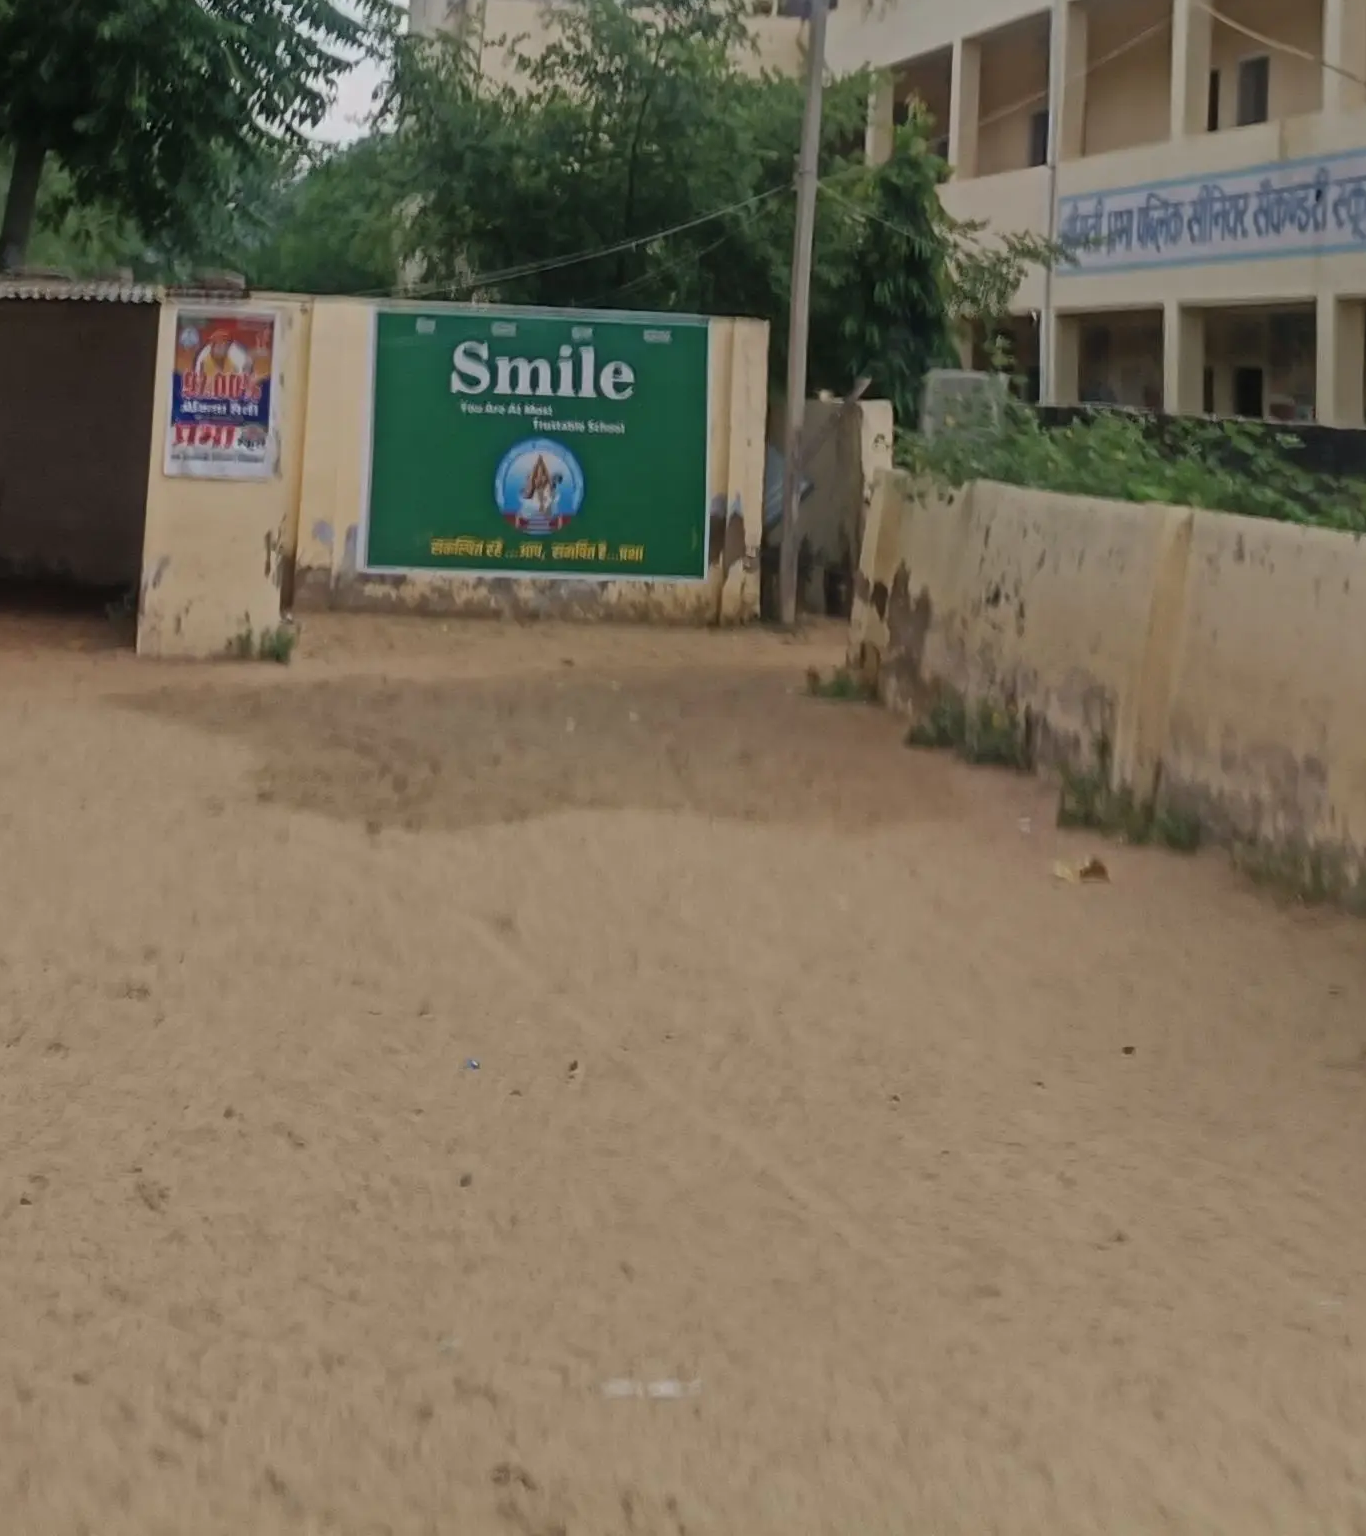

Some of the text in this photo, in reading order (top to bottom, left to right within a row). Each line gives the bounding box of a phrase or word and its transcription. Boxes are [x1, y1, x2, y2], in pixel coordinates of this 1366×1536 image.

[1187, 183, 1250, 244] सीनियर
[450, 340, 634, 401] Smile
[460, 400, 483, 415] You
[485, 402, 506, 415] Are
[524, 403, 553, 417] Most
[587, 419, 626, 434] School
